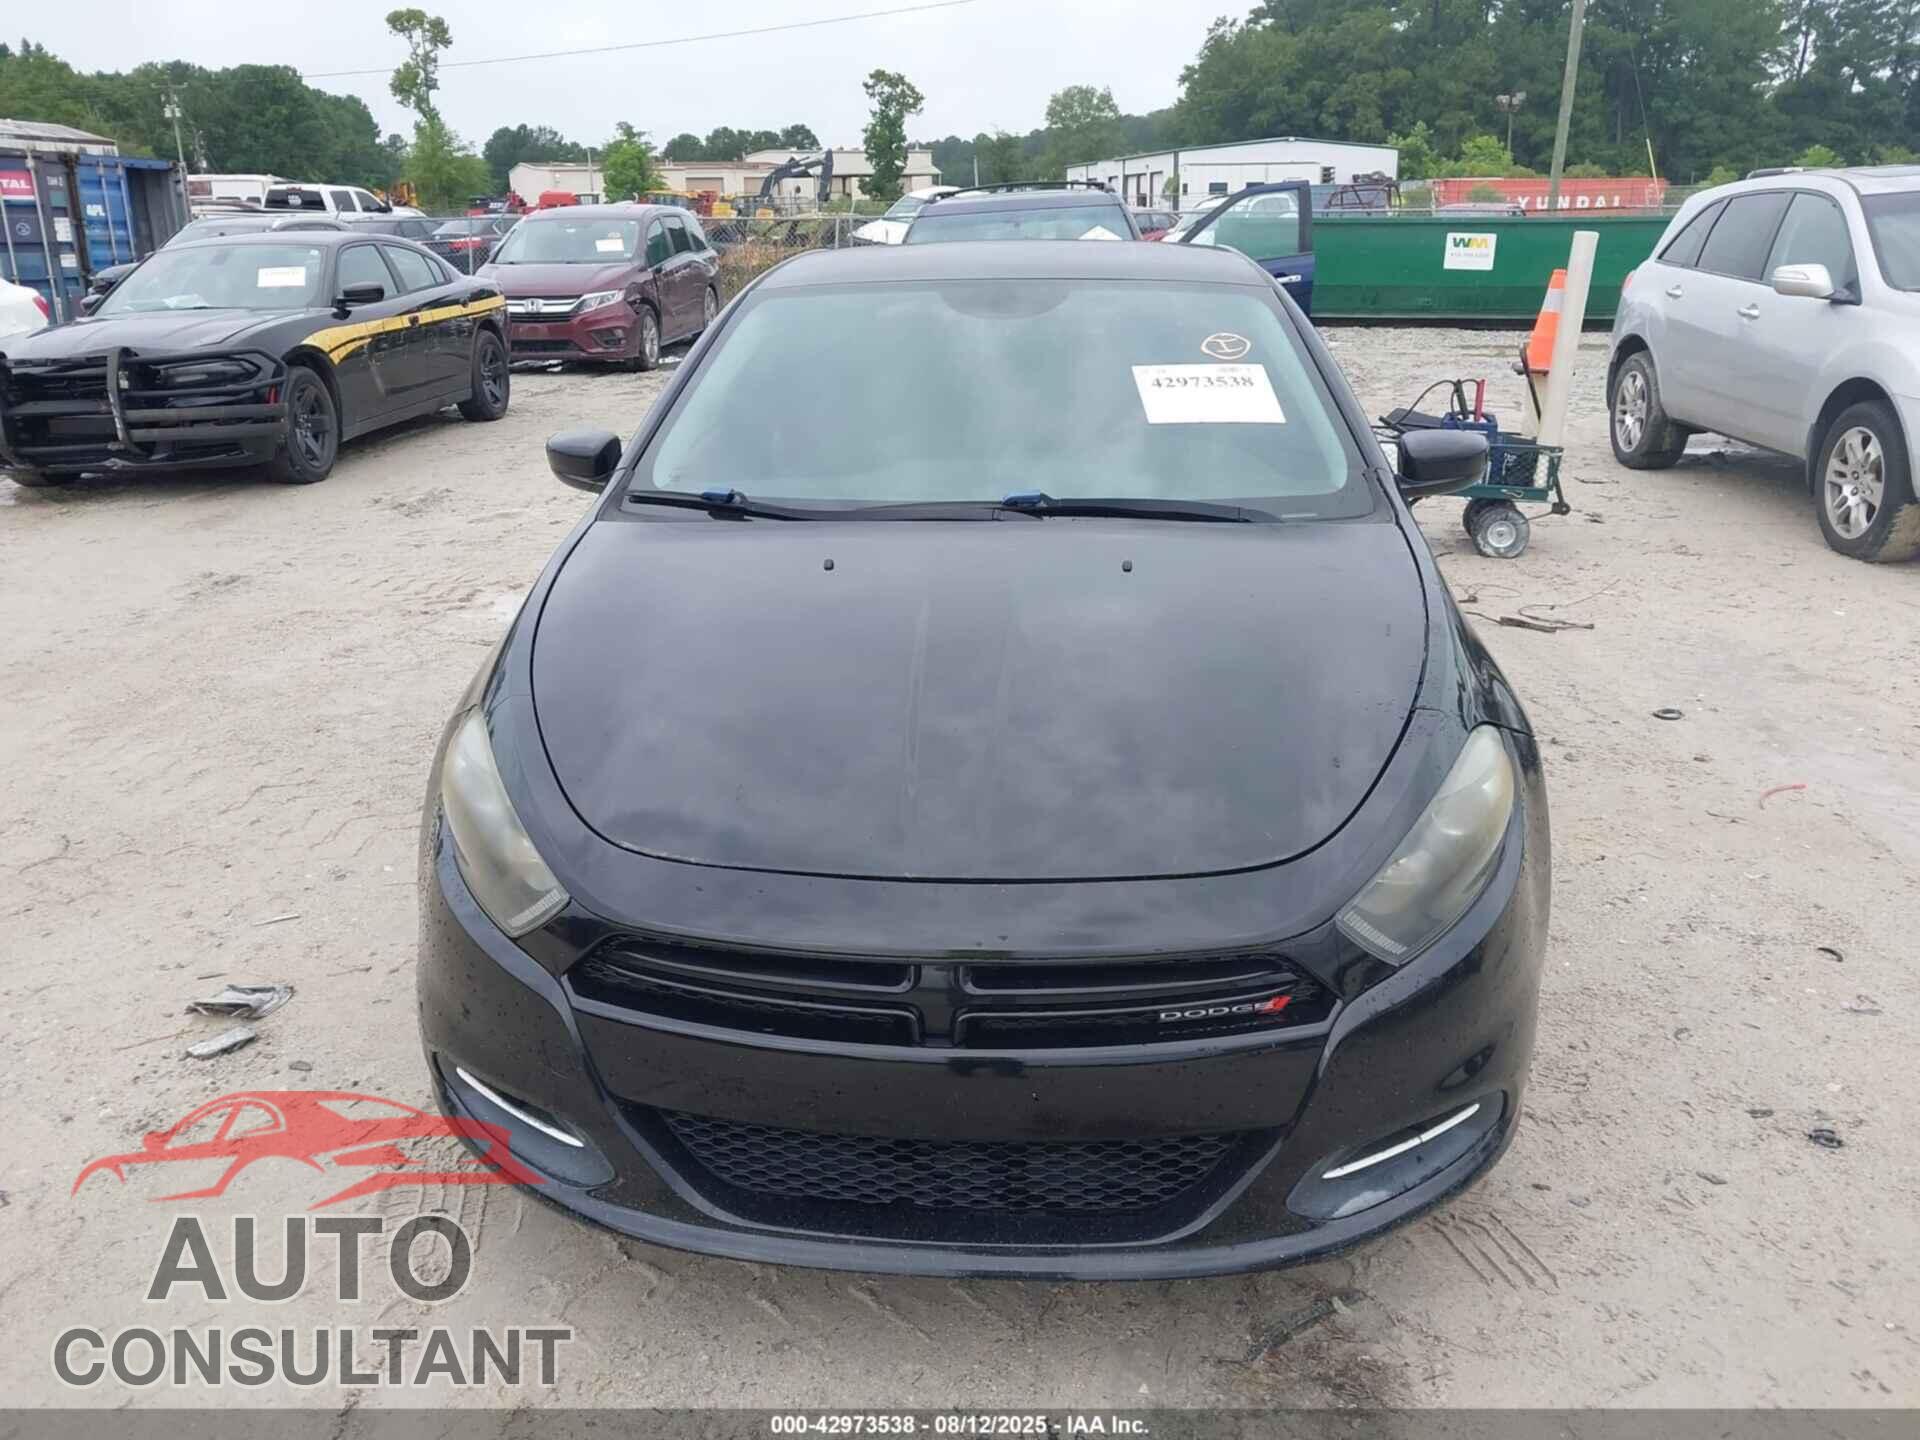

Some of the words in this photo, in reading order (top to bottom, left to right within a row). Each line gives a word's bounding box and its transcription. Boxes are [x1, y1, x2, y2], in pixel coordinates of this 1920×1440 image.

[1505, 196, 1621, 209] YUNDAI
[1453, 237, 1488, 248] WM
[1152, 375, 1254, 388] 42973538
[1159, 1002, 1275, 1020] DODGE
